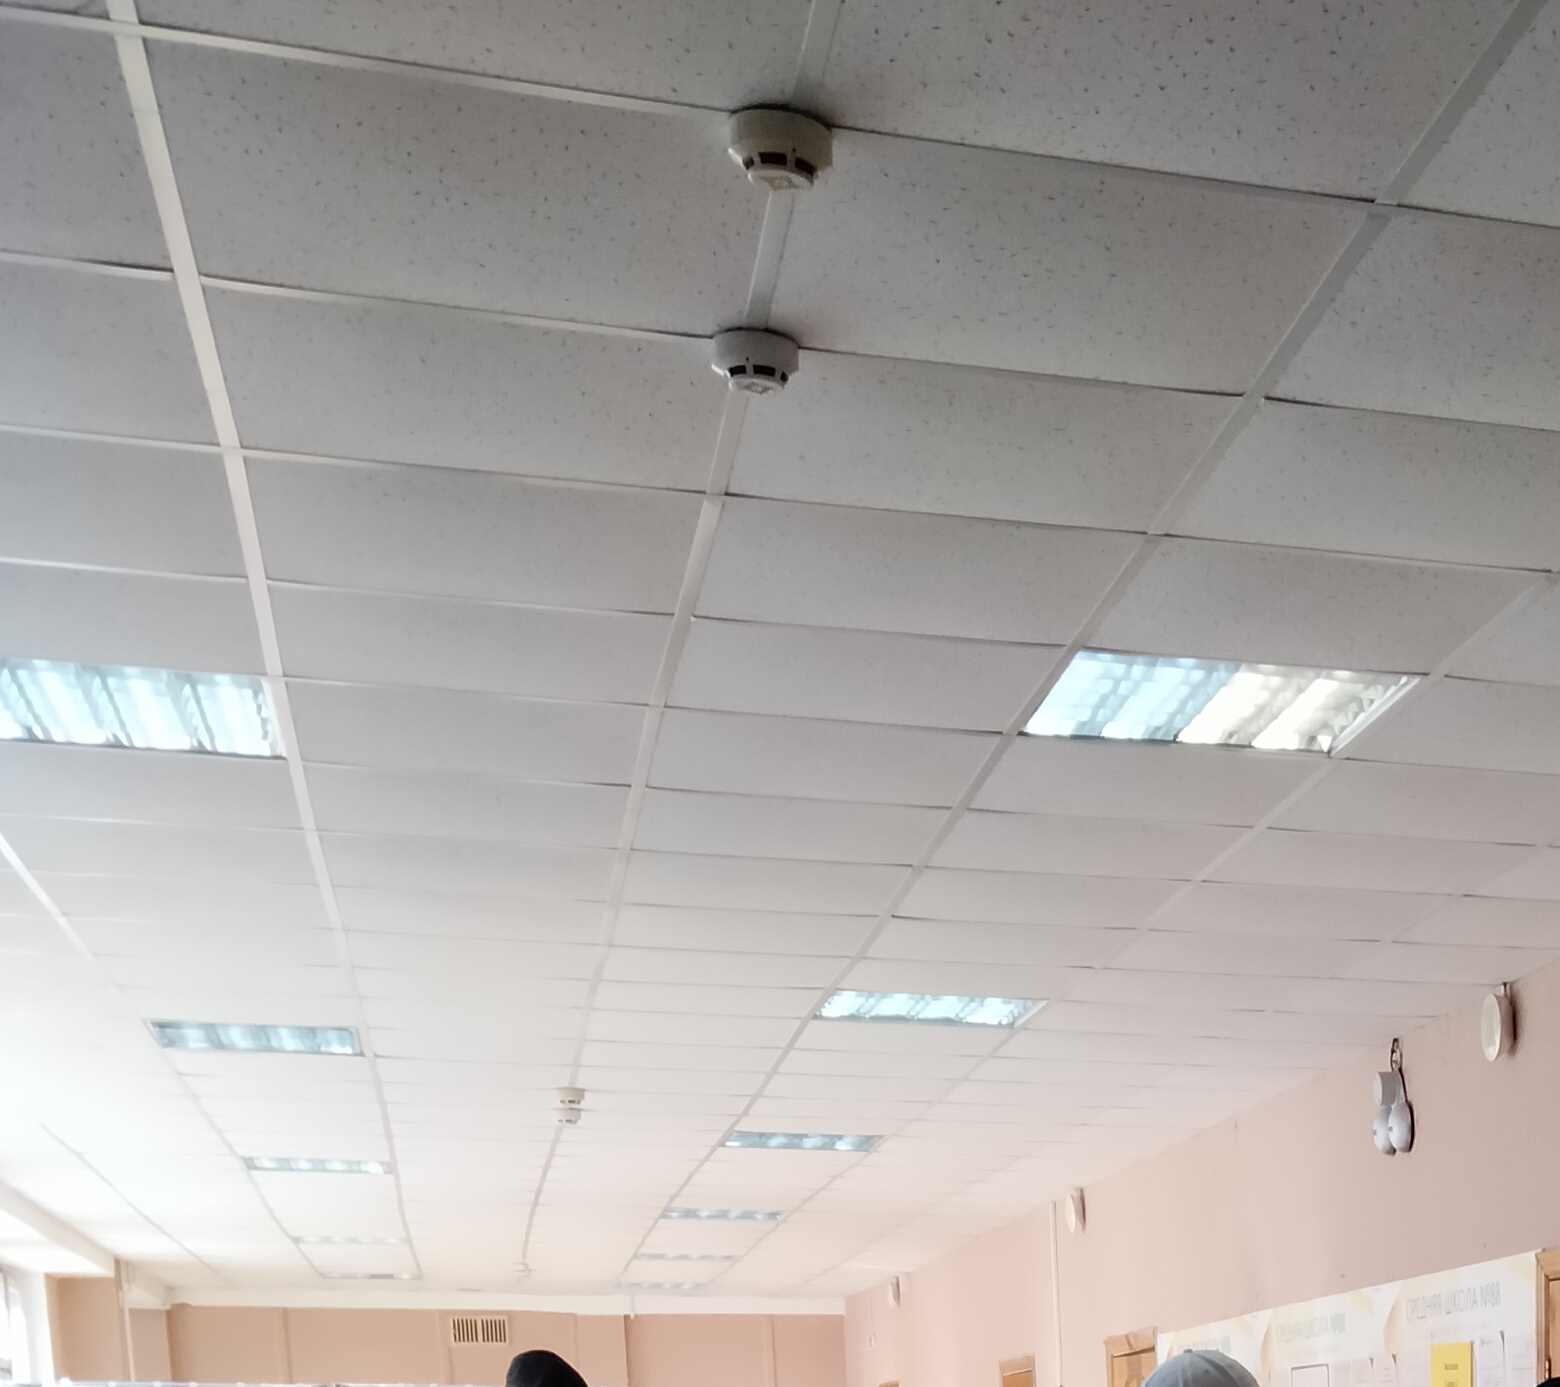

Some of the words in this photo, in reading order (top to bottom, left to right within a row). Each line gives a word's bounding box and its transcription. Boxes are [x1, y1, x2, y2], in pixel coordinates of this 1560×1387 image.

[1406, 1293, 1443, 1322] СРЕДНЯЯ
[1444, 1287, 1478, 1314] ШКОЛА
[1480, 1281, 1501, 1307] №88
